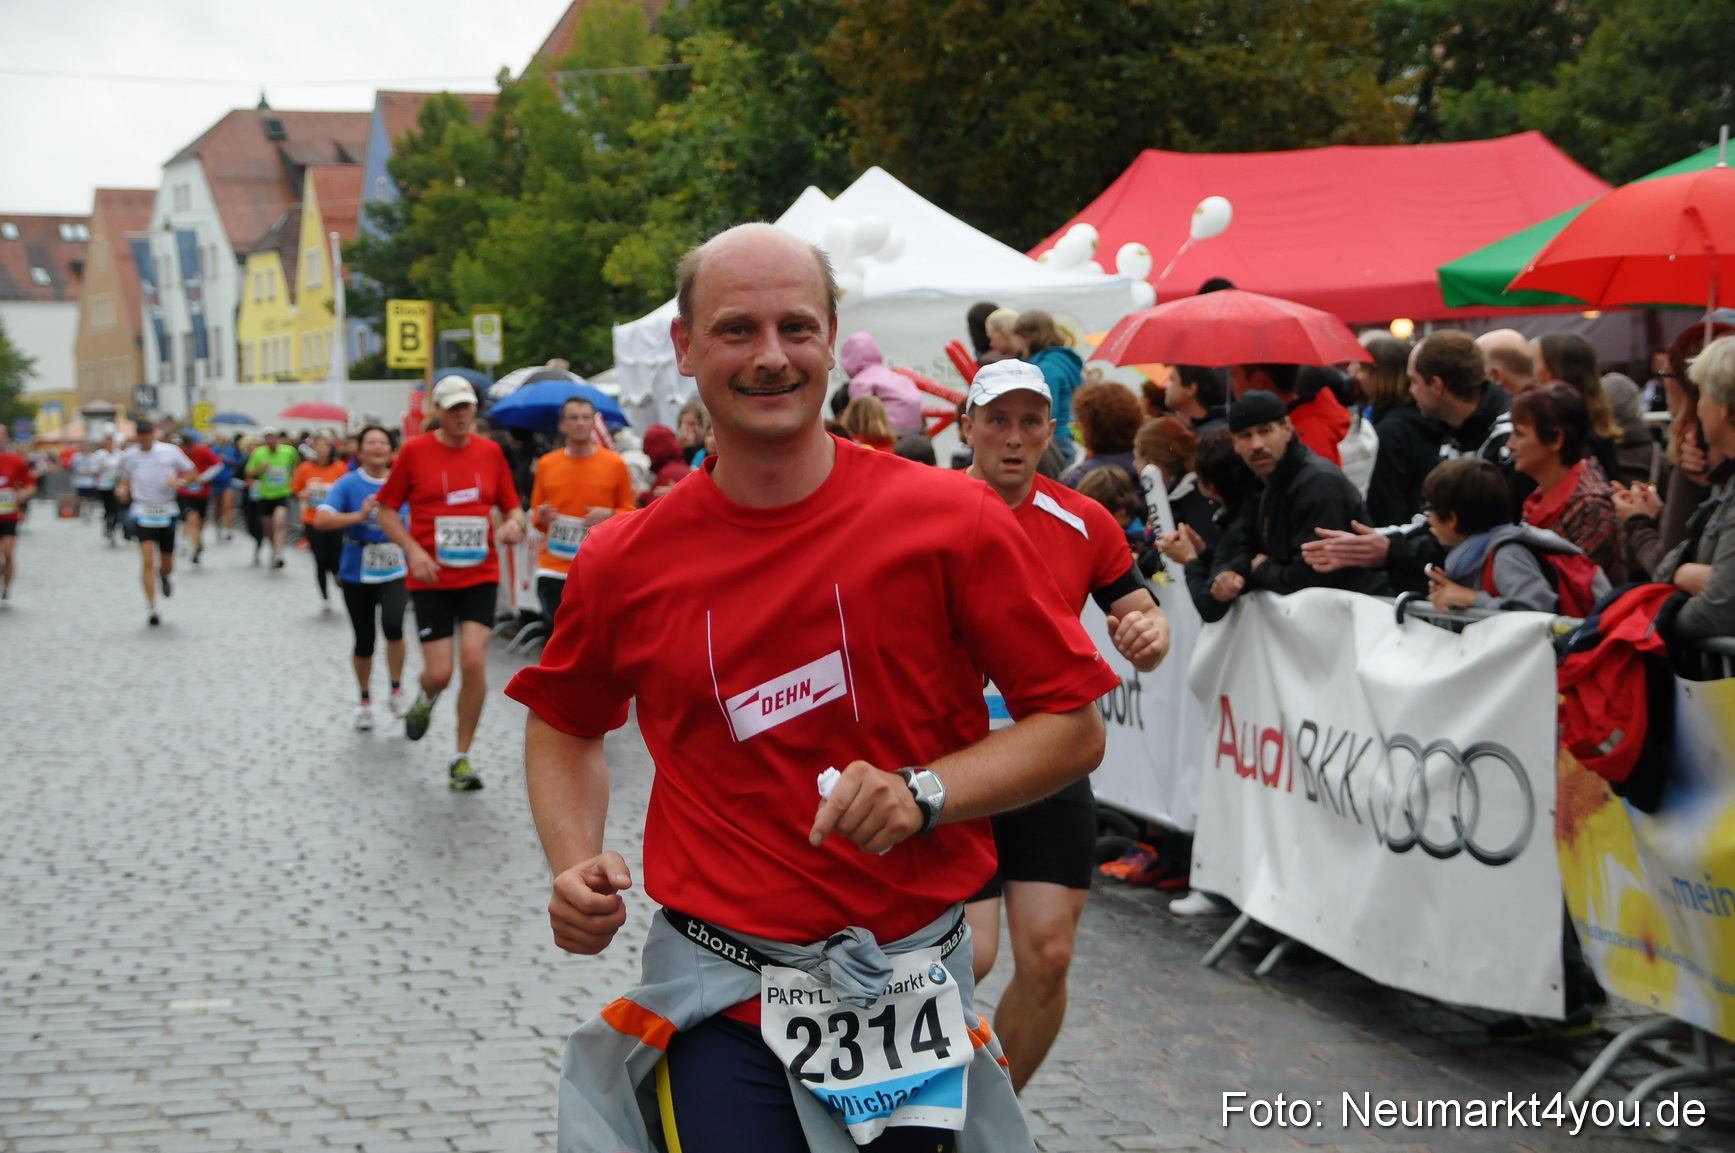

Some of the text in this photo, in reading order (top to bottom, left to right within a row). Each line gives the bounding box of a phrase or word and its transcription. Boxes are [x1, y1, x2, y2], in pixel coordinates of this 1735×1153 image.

[401, 322, 420, 351] B
[761, 677, 811, 717] DEHN
[1216, 694, 1373, 825] Audi BKK
[786, 996, 951, 1084] 2314
